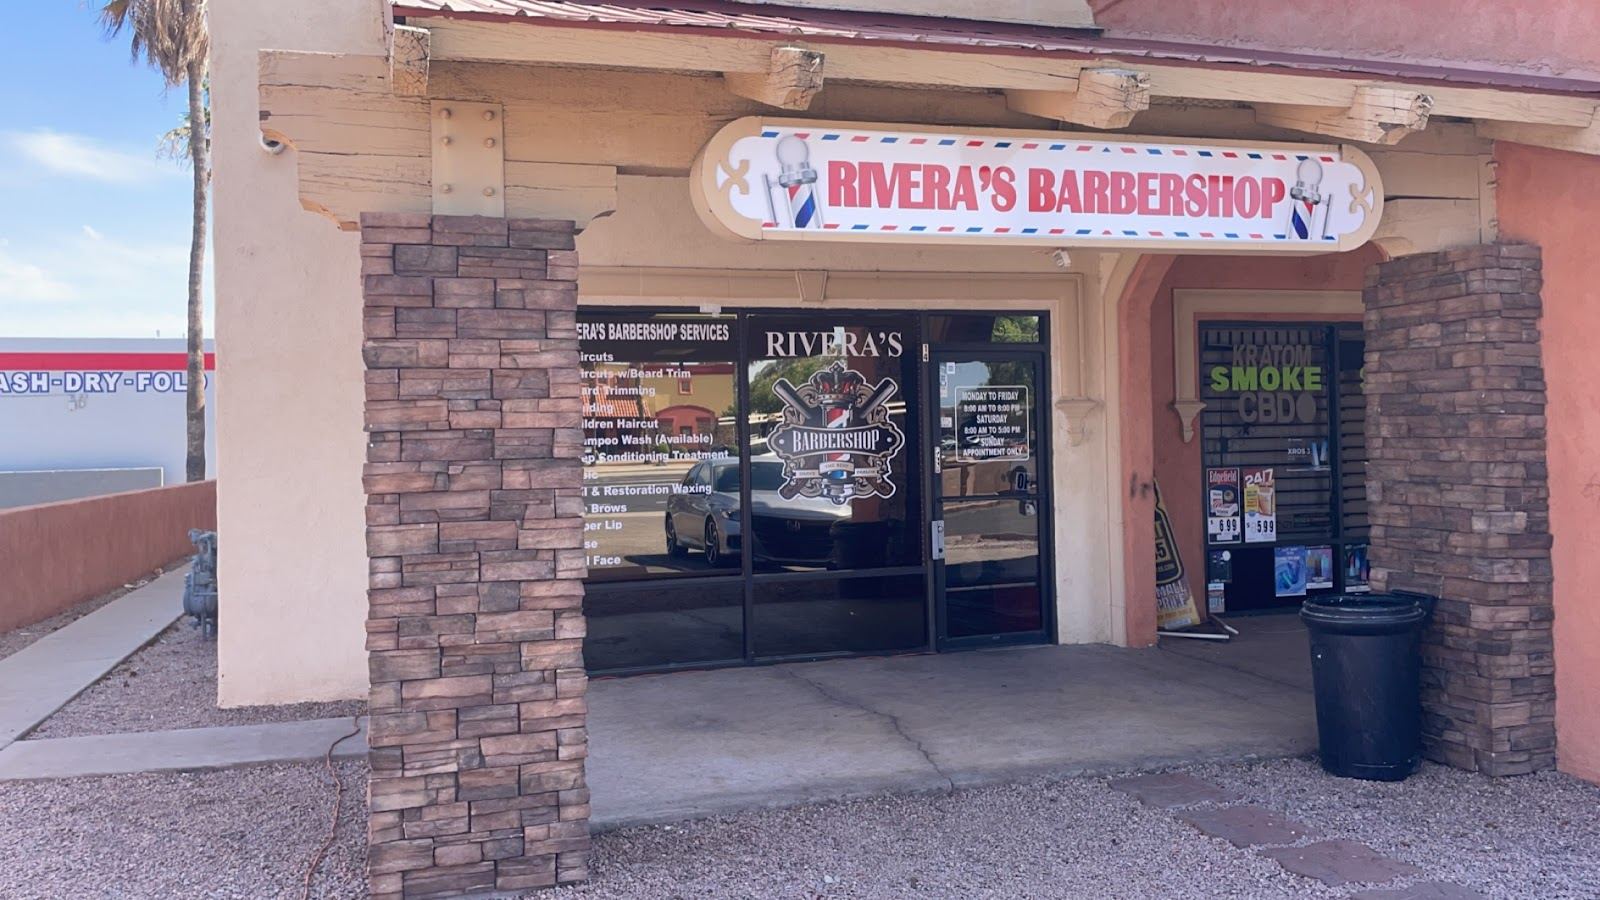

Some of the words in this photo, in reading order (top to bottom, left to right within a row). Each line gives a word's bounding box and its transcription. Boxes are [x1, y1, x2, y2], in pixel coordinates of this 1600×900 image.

[827, 159, 1017, 213] RIVERA'S
[1027, 166, 1286, 220] BARBERSHOP
[576, 322, 606, 340] ERA'S
[608, 323, 678, 341] BARBERSHOP
[679, 323, 730, 341] SERVICES
[765, 331, 904, 358] RIVERA'S
[580, 351, 614, 362] ircuts
[1231, 344, 1313, 368] KRATOM
[580, 368, 614, 379] ircuts
[617, 368, 664, 379] w/Beard
[665, 368, 691, 379] Trim
[1210, 366, 1322, 392] SMOKE
[581, 386, 600, 396] ard
[604, 386, 656, 398] Trimming
[962, 391, 987, 401] MONDAY
[988, 391, 997, 401] TO
[997, 390, 1019, 401] FRIDAY
[978, 404, 988, 412] AM
[988, 404, 997, 412] TO
[1010, 404, 1021, 412] PM
[1237, 391, 1296, 424] CBD
[581, 418, 614, 429] ildren
[616, 418, 659, 429] Haircut
[976, 414, 1008, 424] SATURDAY
[978, 426, 988, 434] AM
[988, 426, 998, 434] TO
[998, 426, 1011, 434] 5:00
[1011, 425, 1021, 434] PM
[621, 434, 652, 446] Wash
[655, 433, 714, 447] (Available)
[792, 428, 880, 453] BARBERSHOP
[980, 436, 1005, 447] SUNDAY
[599, 452, 670, 465] Conditioning
[672, 449, 730, 461] Treatment
[963, 447, 1006, 457] APPOINTMENT
[1006, 447, 1023, 456] ONLY
[1209, 469, 1238, 484] Edgefield
[591, 486, 601, 497] &
[603, 484, 669, 497] Restoration
[672, 483, 712, 496] Waxing
[591, 503, 628, 513] Brows
[604, 519, 623, 531] Lip
[593, 554, 622, 565] Face
